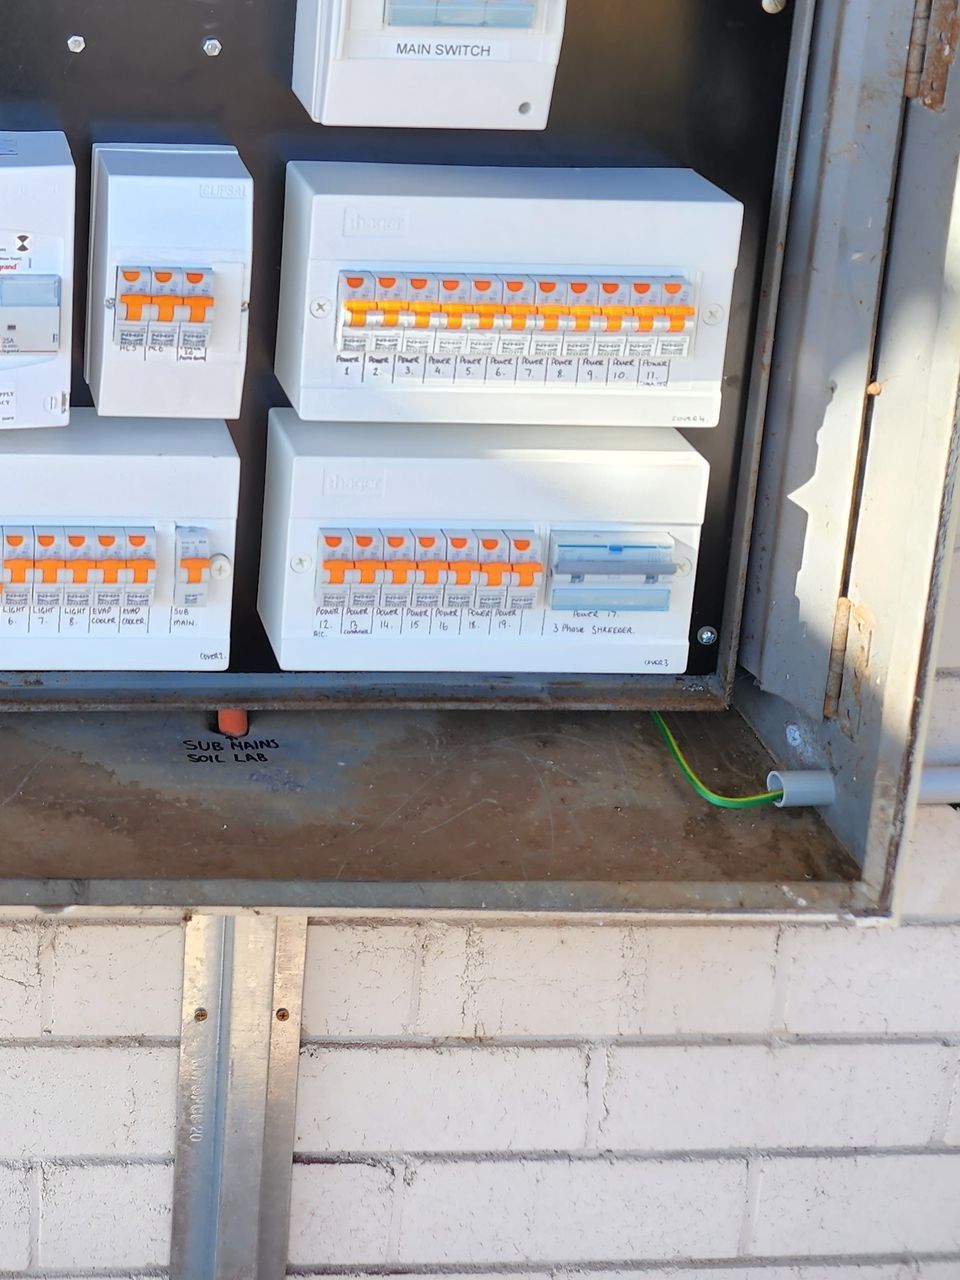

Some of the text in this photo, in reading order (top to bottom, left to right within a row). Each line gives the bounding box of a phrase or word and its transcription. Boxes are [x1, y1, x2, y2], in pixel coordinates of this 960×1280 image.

[396, 42, 491, 57] MAIN SWITCH
[3, 606, 26, 614] LIGHT
[33, 606, 55, 614] LIGHT
[64, 607, 86, 615] LIGHT
[553, 623, 559, 633] 3
[183, 738, 280, 751] SUB MAINS
[187, 753, 269, 763] SOIL LAB
